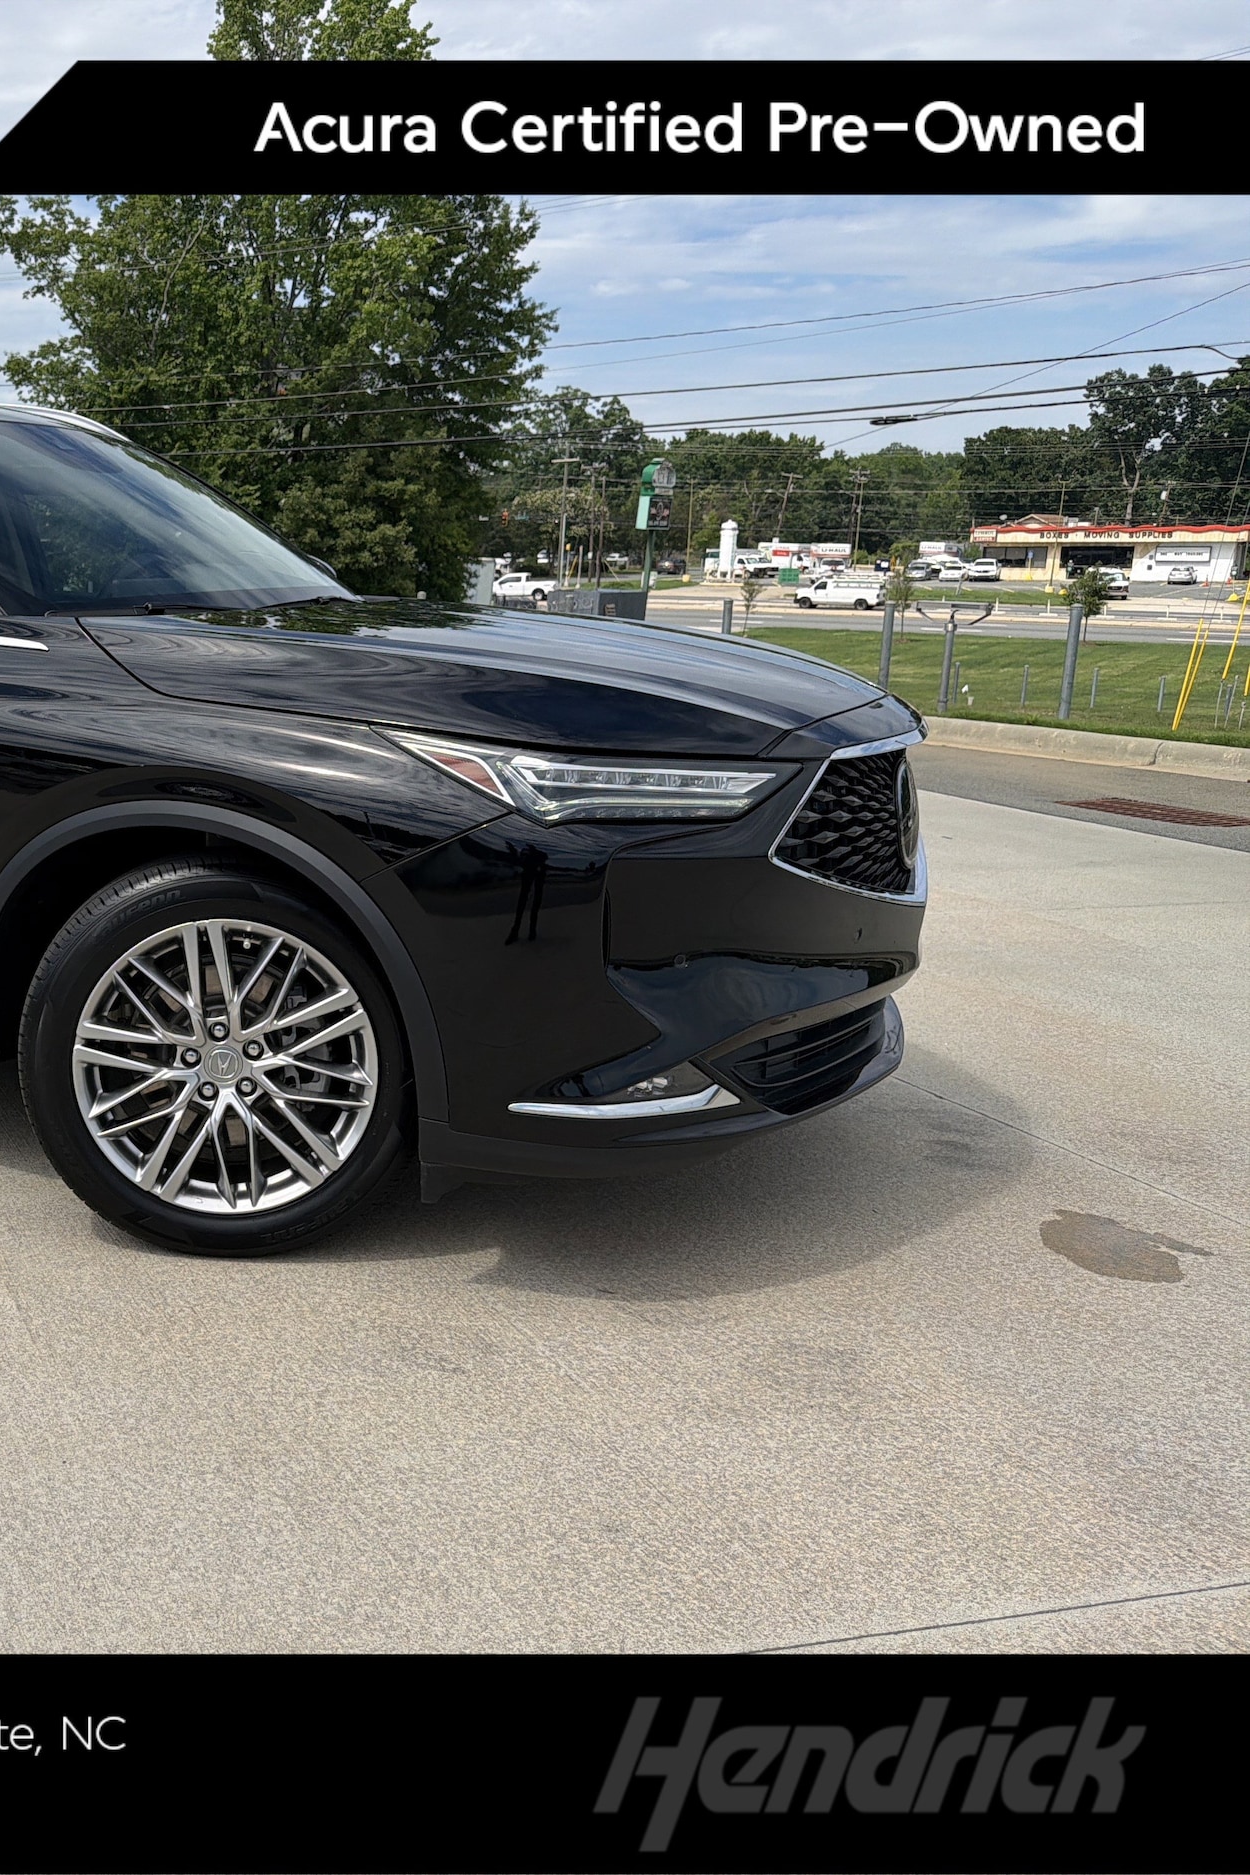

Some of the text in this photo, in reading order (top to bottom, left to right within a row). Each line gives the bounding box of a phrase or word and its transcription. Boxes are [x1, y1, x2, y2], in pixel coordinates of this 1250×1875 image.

[1039, 531, 1173, 539] BOXES MOVING SUPPLIES
